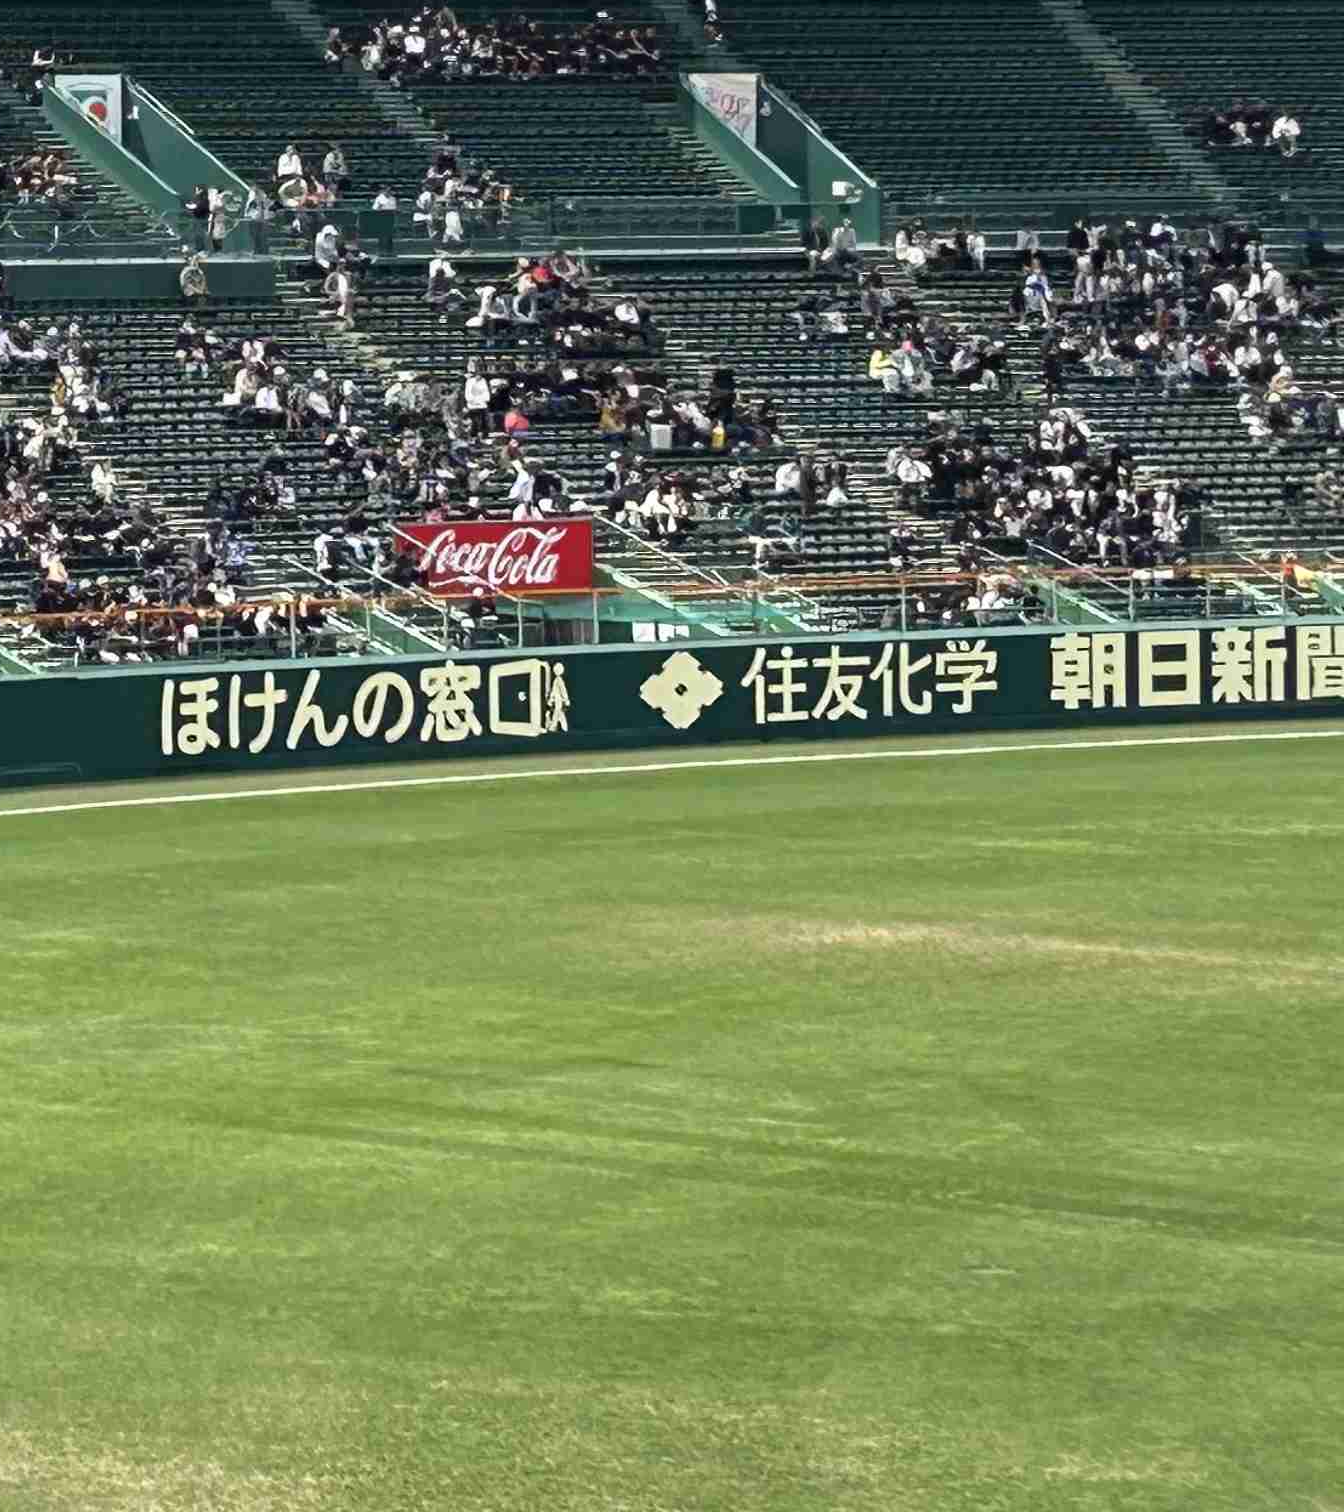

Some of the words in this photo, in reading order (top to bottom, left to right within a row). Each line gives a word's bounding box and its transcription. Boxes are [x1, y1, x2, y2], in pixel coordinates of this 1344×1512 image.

[160, 658, 550, 756] ほけんの窓口
[743, 641, 998, 725] 住友化学
[1050, 625, 1344, 709] 朝日新聞
